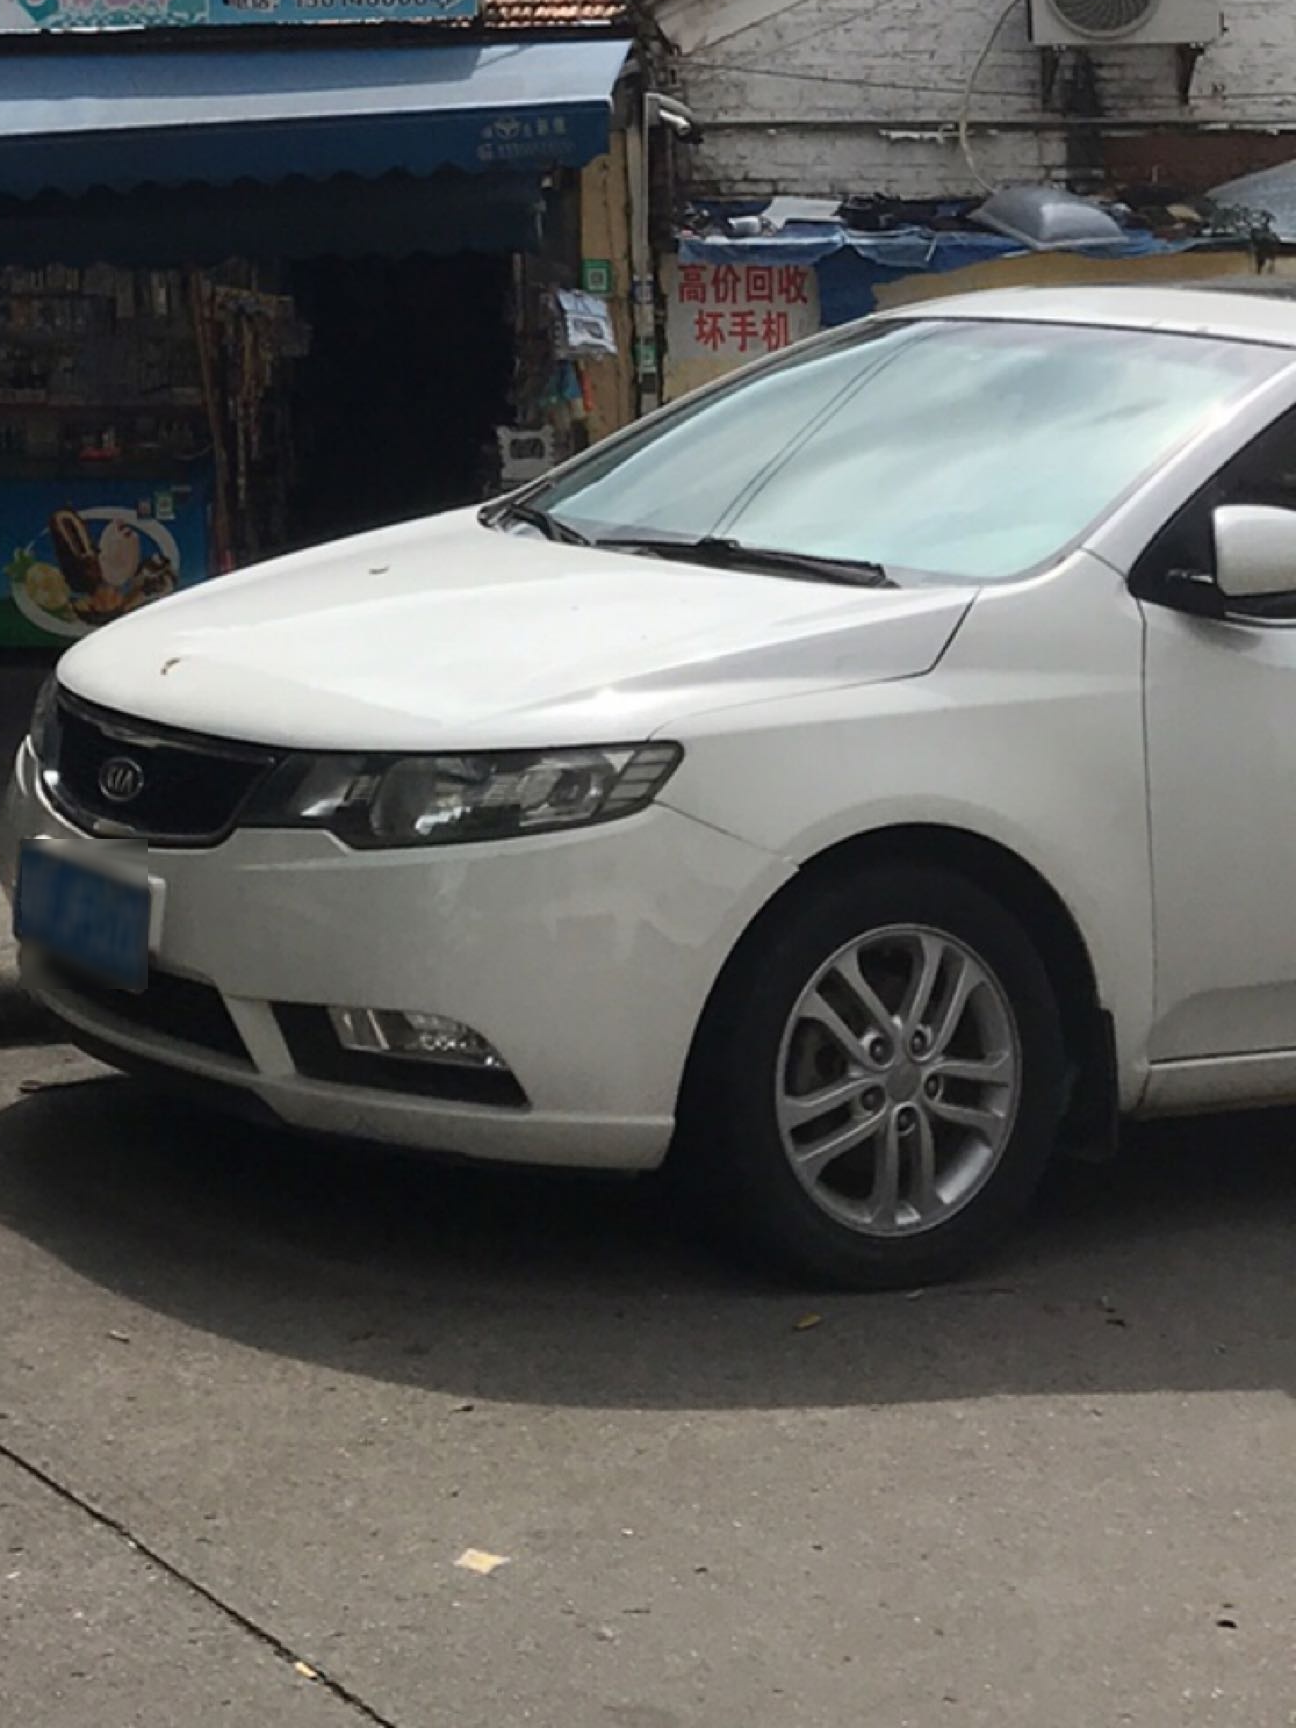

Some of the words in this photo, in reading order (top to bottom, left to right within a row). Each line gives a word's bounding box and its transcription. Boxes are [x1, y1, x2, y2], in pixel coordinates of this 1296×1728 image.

[678, 263, 807, 304] 高价回收
[694, 309, 790, 352] 坏手机
